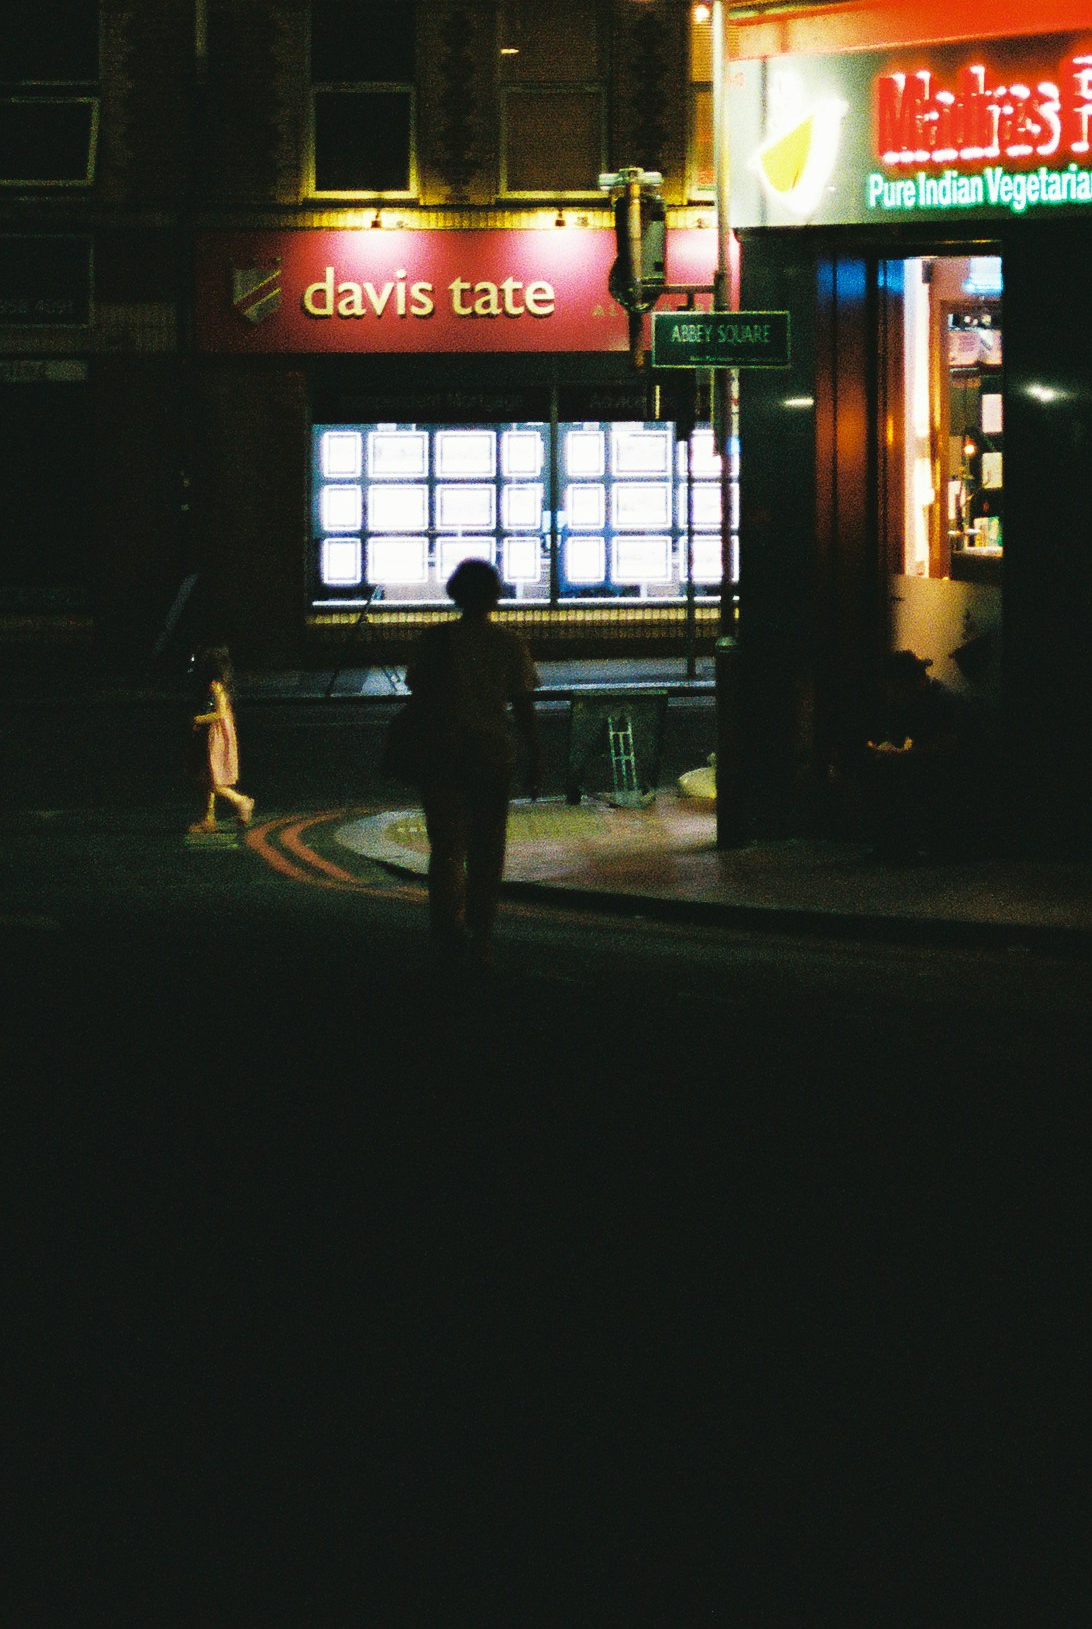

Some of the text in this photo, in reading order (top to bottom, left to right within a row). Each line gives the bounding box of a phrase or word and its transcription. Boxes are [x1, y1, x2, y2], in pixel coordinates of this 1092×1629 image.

[878, 65, 1061, 163] Madras
[868, 172, 916, 208] Pure
[917, 170, 983, 207] Indian
[303, 266, 555, 317] davis tate
[671, 324, 771, 346] ABBEY SQUARE
